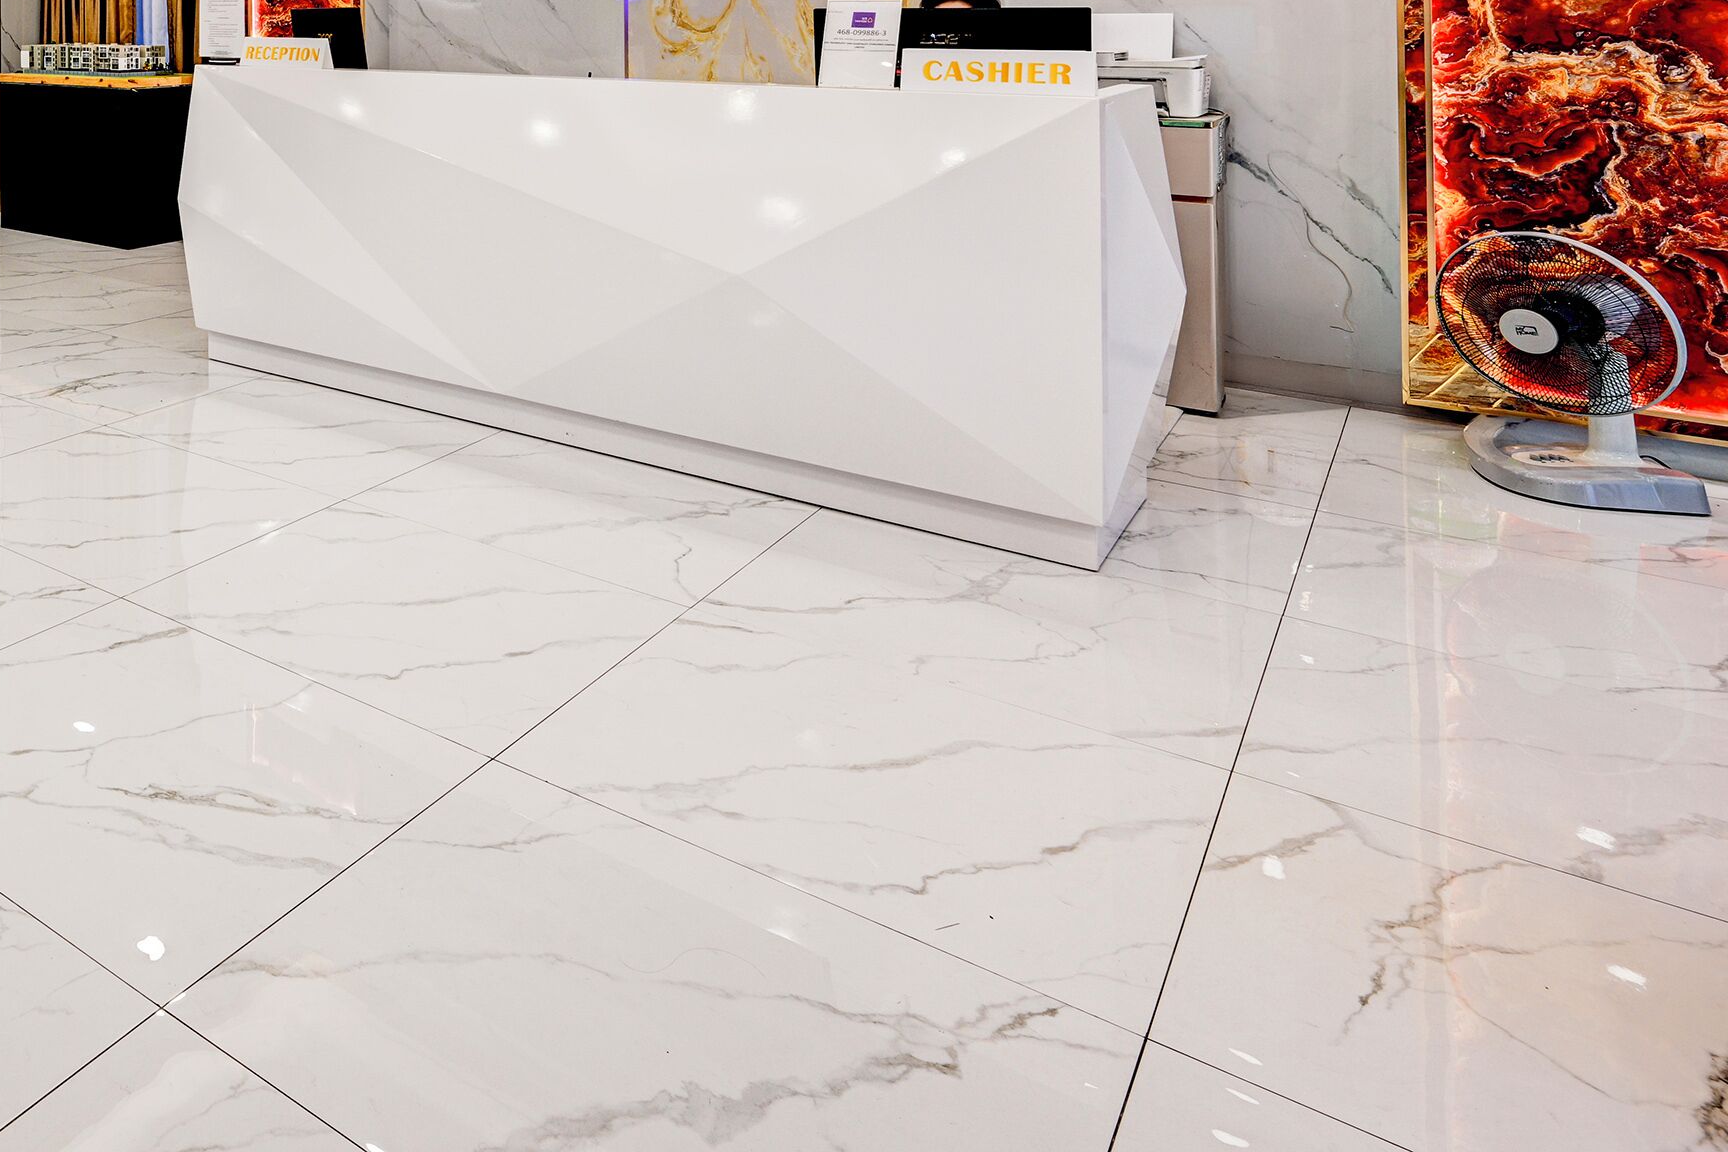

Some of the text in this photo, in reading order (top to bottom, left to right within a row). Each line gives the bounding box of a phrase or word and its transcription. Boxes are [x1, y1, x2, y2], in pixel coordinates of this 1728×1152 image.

[836, 28, 887, 37] 468-099886-3
[245, 45, 321, 62] RECEPTION
[922, 59, 1072, 85] CASHIER
